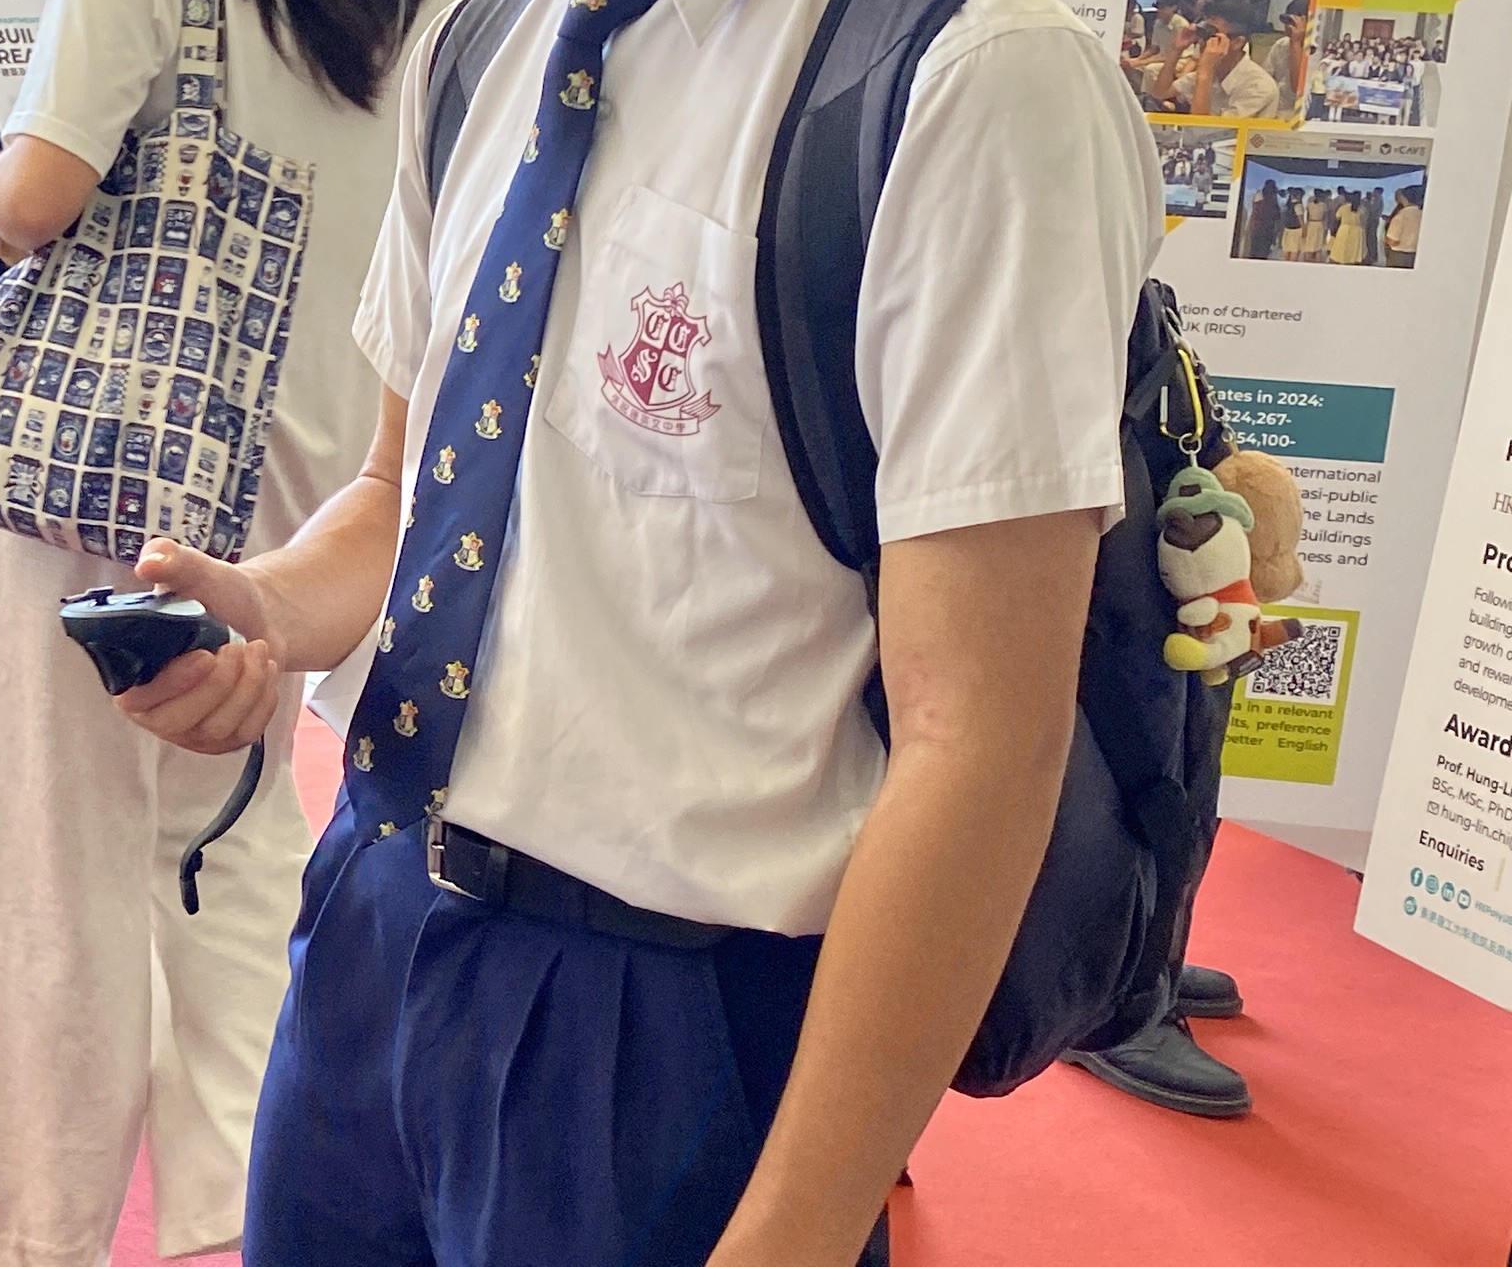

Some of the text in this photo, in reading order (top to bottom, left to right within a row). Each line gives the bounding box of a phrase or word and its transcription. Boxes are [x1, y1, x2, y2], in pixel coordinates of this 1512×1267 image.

[1213, 305, 1229, 317] of
[1231, 306, 1303, 322] Chartered
[1204, 322, 1246, 338] (RICS)
[1256, 389, 1273, 404] in
[1276, 392, 1324, 408] 2024:
[1327, 510, 1375, 525] Lands
[1337, 553, 1368, 566] and
[1463, 634, 1504, 659] growth
[1458, 656, 1482, 674] and
[1248, 701, 1259, 711] in
[1264, 704, 1273, 714] a
[1277, 705, 1334, 720] relevant
[1256, 720, 1332, 736] preference
[1277, 737, 1328, 753] English
[1437, 754, 1464, 778] Prof.
[1432, 776, 1456, 800] BSc,
[1457, 787, 1485, 811] MSc,
[1419, 828, 1485, 872] Enquiries
